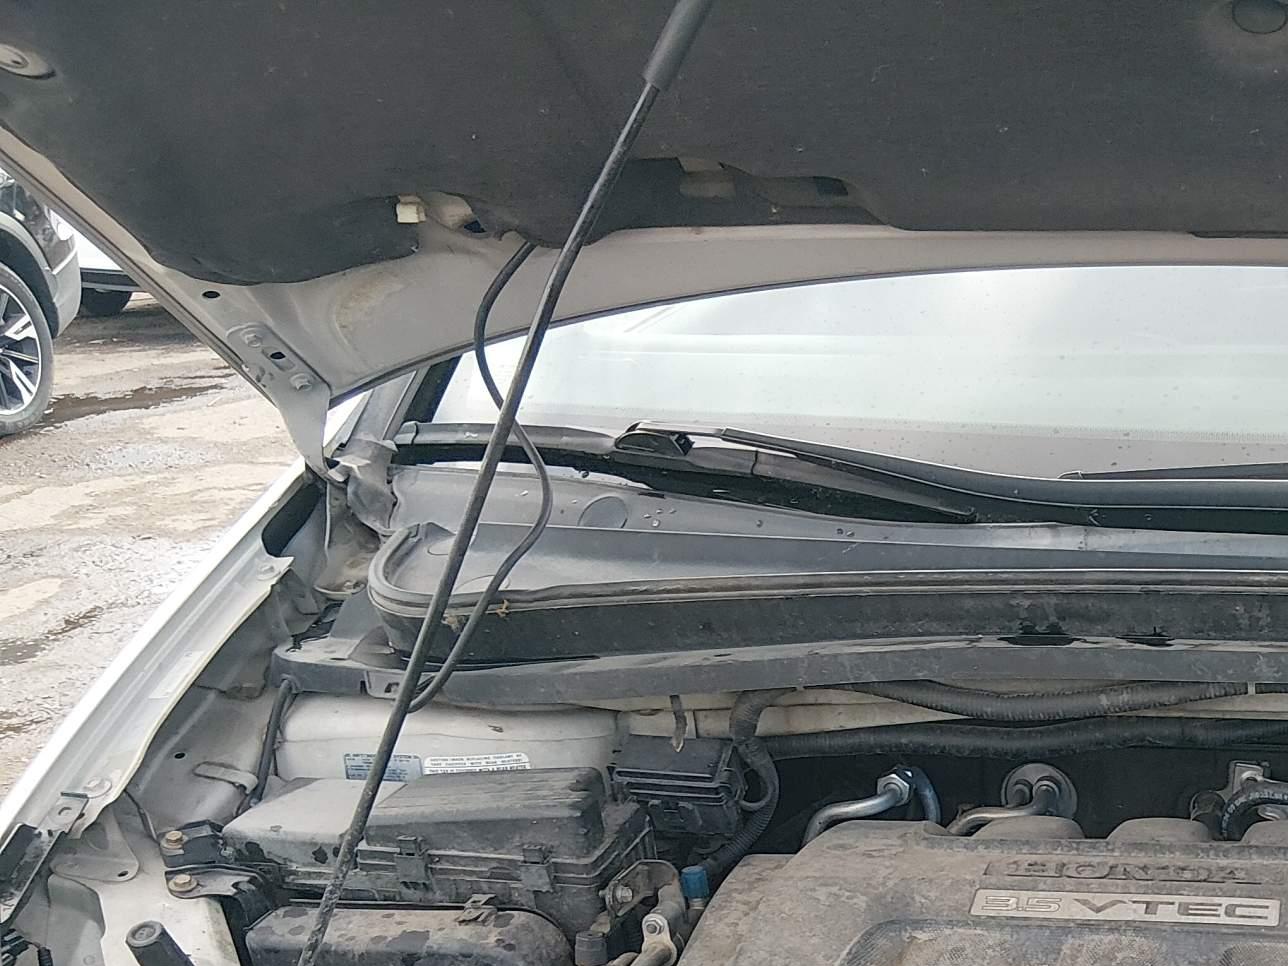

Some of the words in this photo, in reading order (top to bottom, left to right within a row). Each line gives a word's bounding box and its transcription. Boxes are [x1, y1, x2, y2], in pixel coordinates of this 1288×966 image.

[1003, 861, 1263, 885] HONDA
[981, 894, 1062, 913] 3.5
[1072, 898, 1270, 919] VTEC
